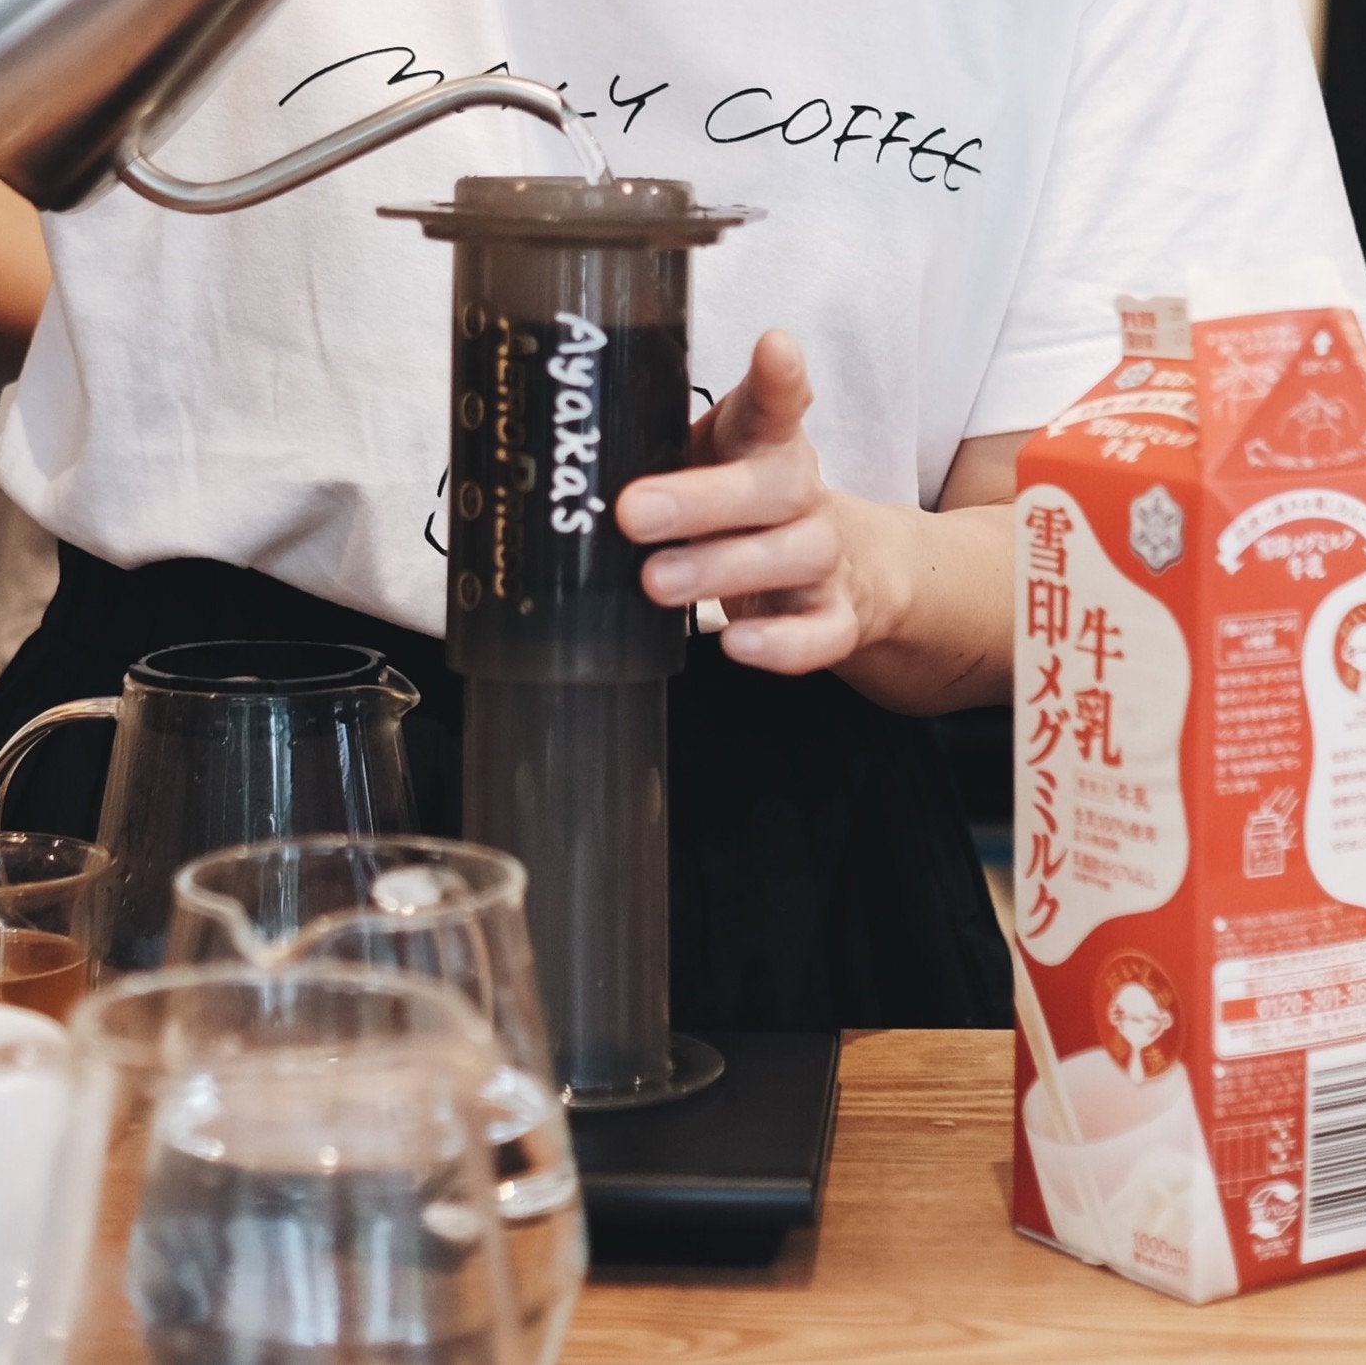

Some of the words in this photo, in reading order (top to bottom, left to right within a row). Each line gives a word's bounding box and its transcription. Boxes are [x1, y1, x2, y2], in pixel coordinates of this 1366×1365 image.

[704, 86, 982, 192] COFFEE
[1025, 505, 1072, 940] 雪印メグミルク
[1072, 606, 1125, 770] 牛乳
